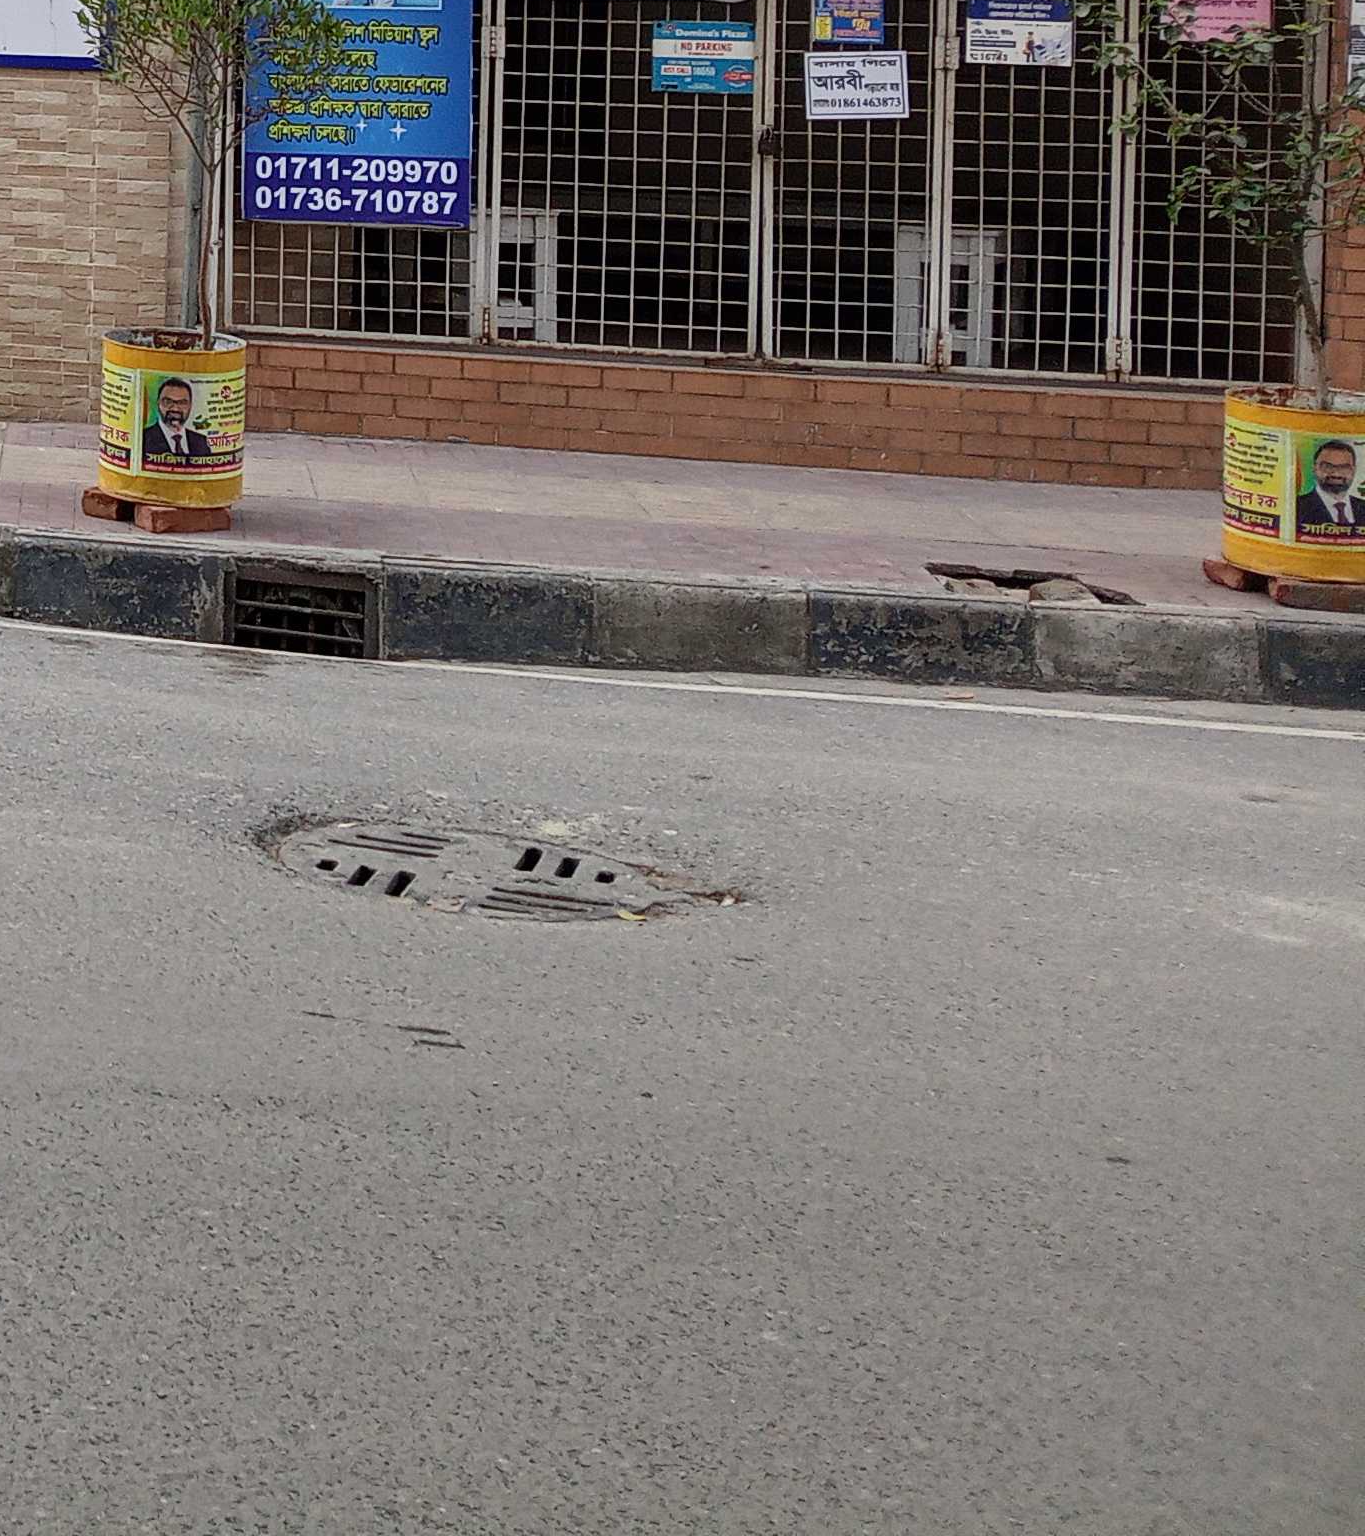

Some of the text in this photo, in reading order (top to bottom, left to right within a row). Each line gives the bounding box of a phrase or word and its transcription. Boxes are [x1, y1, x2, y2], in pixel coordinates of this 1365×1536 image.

[809, 69, 866, 91] আরবী
[254, 155, 458, 186] 01711-209970
[254, 185, 458, 215] 01736-710787
